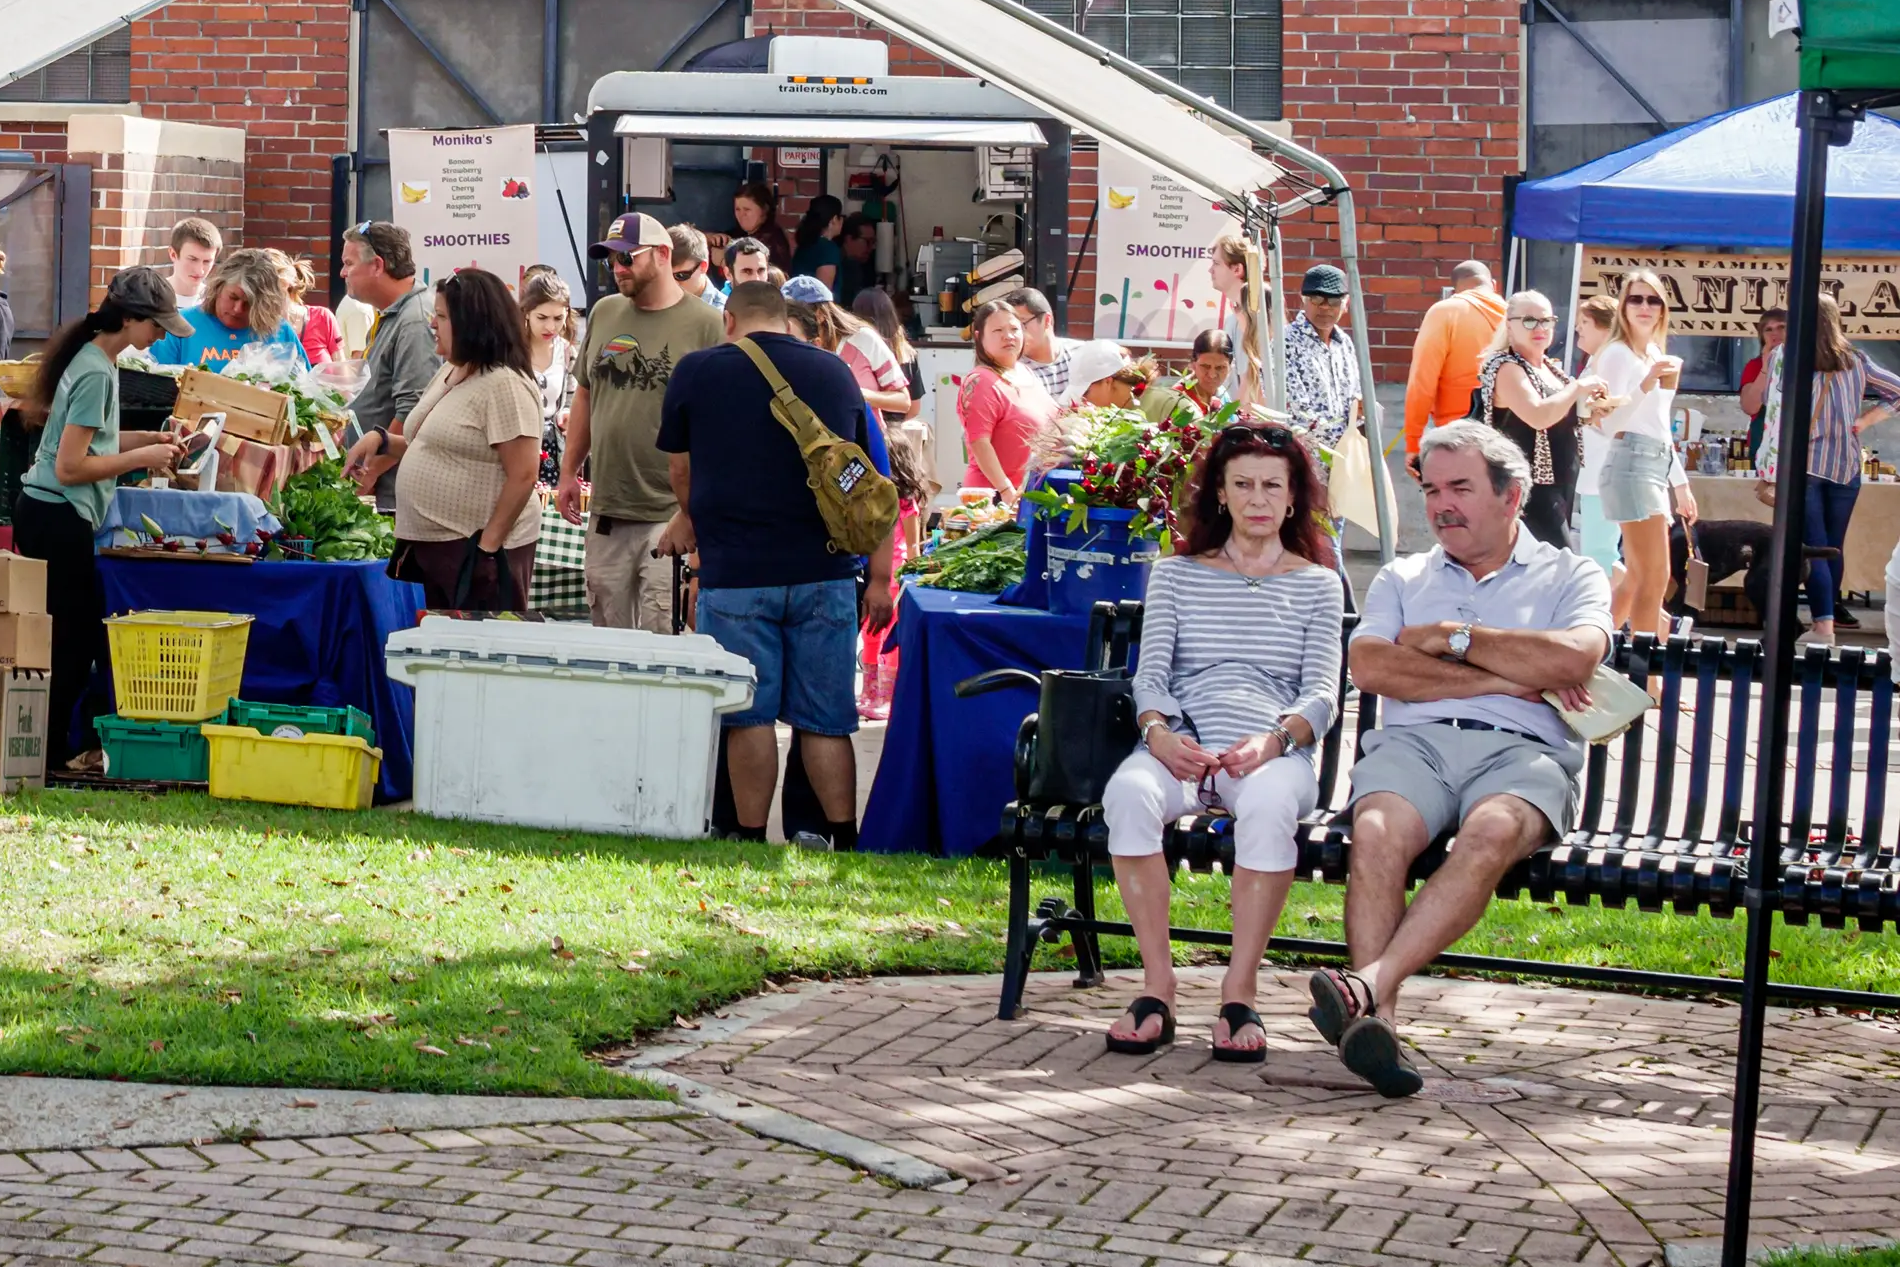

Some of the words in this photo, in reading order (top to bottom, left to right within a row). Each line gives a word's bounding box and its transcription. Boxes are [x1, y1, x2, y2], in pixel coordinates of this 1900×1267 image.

[778, 84, 888, 96] trailersbybob.com
[432, 133, 493, 147] Monika's
[442, 166, 482, 175] Strawberry
[451, 185, 475, 193] Cherry
[452, 193, 475, 201] Lemon
[1160, 194, 1183, 203] Cherry
[446, 202, 482, 212] Raspberry
[1160, 203, 1183, 211] Lemon
[452, 211, 476, 219] Mango
[1153, 212, 1189, 222] Raspberry
[1158, 222, 1183, 230] Mango
[423, 233, 510, 247] SMOOTHIES
[1126, 244, 1214, 260] SMOOTHIES
[1591, 256, 1687, 268] MANNIX
[1697, 260, 1788, 271] FAMILY
[1820, 263, 1898, 274] REMIU
[8, 736, 42, 758] VEGETABLES
